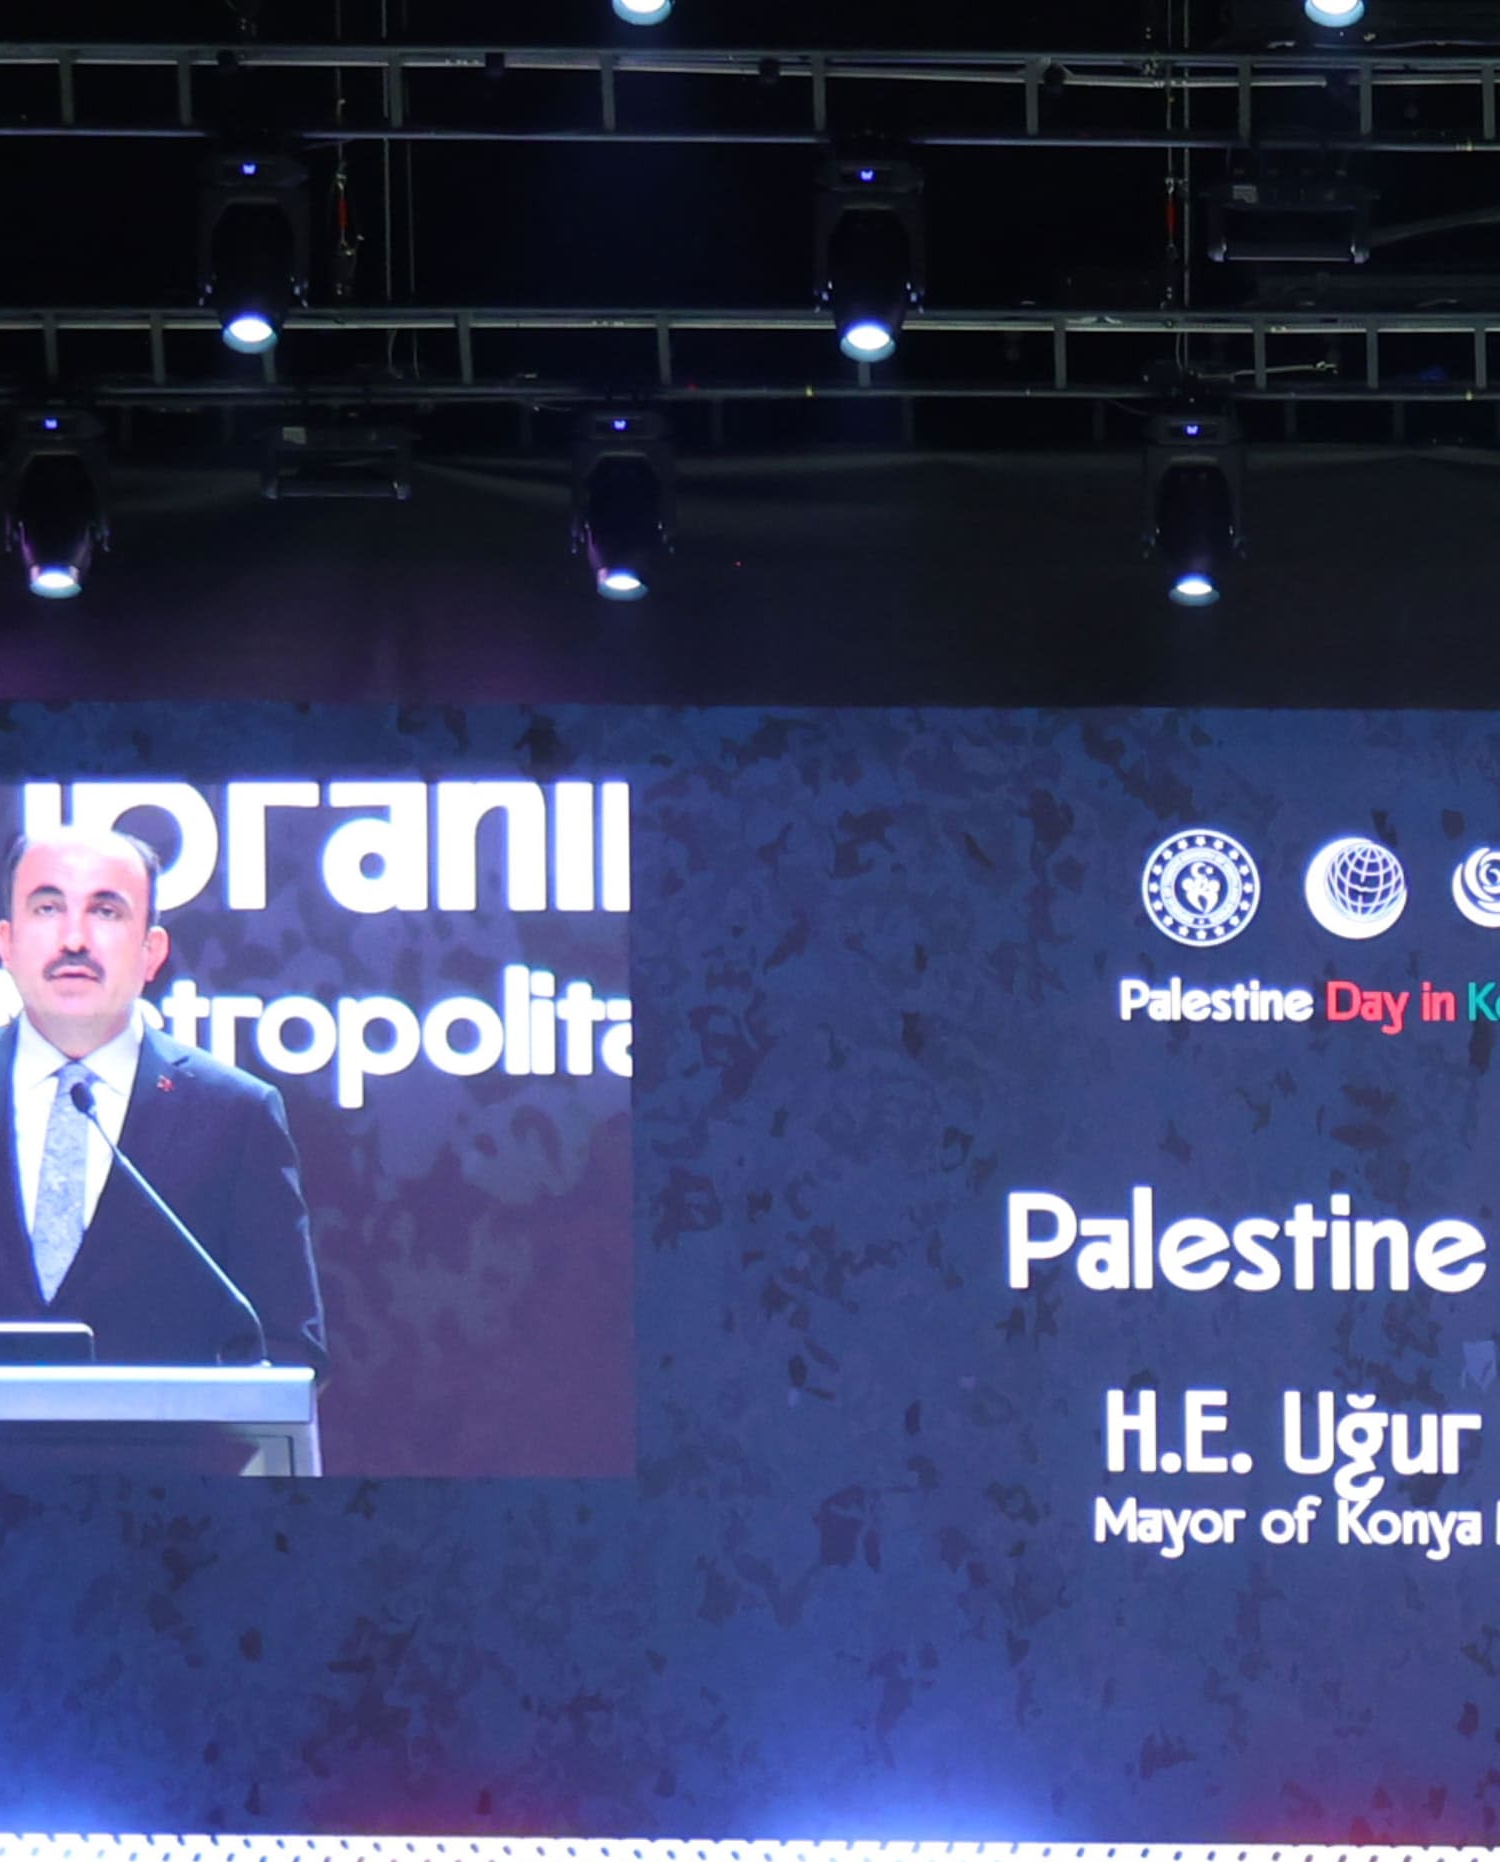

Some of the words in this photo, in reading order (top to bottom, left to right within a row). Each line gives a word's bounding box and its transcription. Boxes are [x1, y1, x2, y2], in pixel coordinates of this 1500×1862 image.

[1121, 978, 1314, 1022] Palestine
[1327, 981, 1409, 1034] Day
[1422, 982, 1455, 1022] in
[1007, 1186, 1487, 1292] Palestine
[1105, 1390, 1253, 1474] H.E.
[1283, 1391, 1481, 1503] Uğur
[1094, 1497, 1246, 1558] Mayor
[1261, 1496, 1322, 1544] of
[1336, 1497, 1482, 1561] Konya
